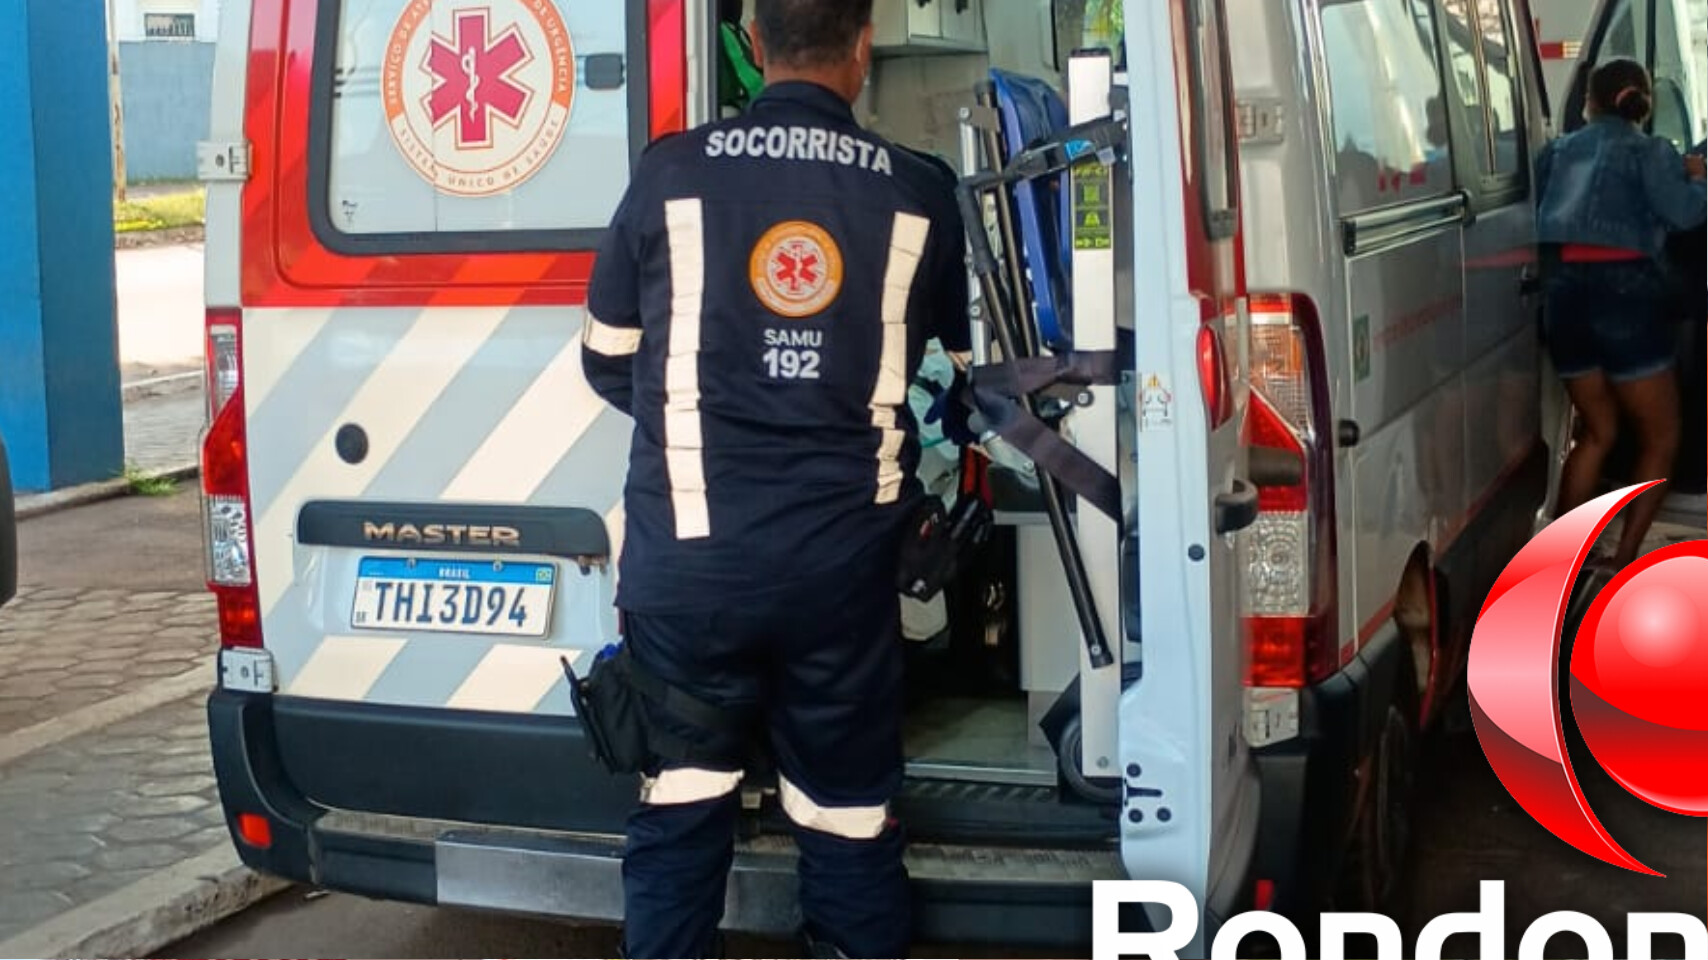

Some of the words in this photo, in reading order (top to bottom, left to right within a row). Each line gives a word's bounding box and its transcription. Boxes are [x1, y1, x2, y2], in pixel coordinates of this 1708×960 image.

[705, 126, 892, 176] SOCORRISTA
[763, 328, 823, 347] SAMU
[763, 348, 821, 379] 192
[363, 521, 520, 547] MASTER
[375, 582, 527, 628] THI3D94
